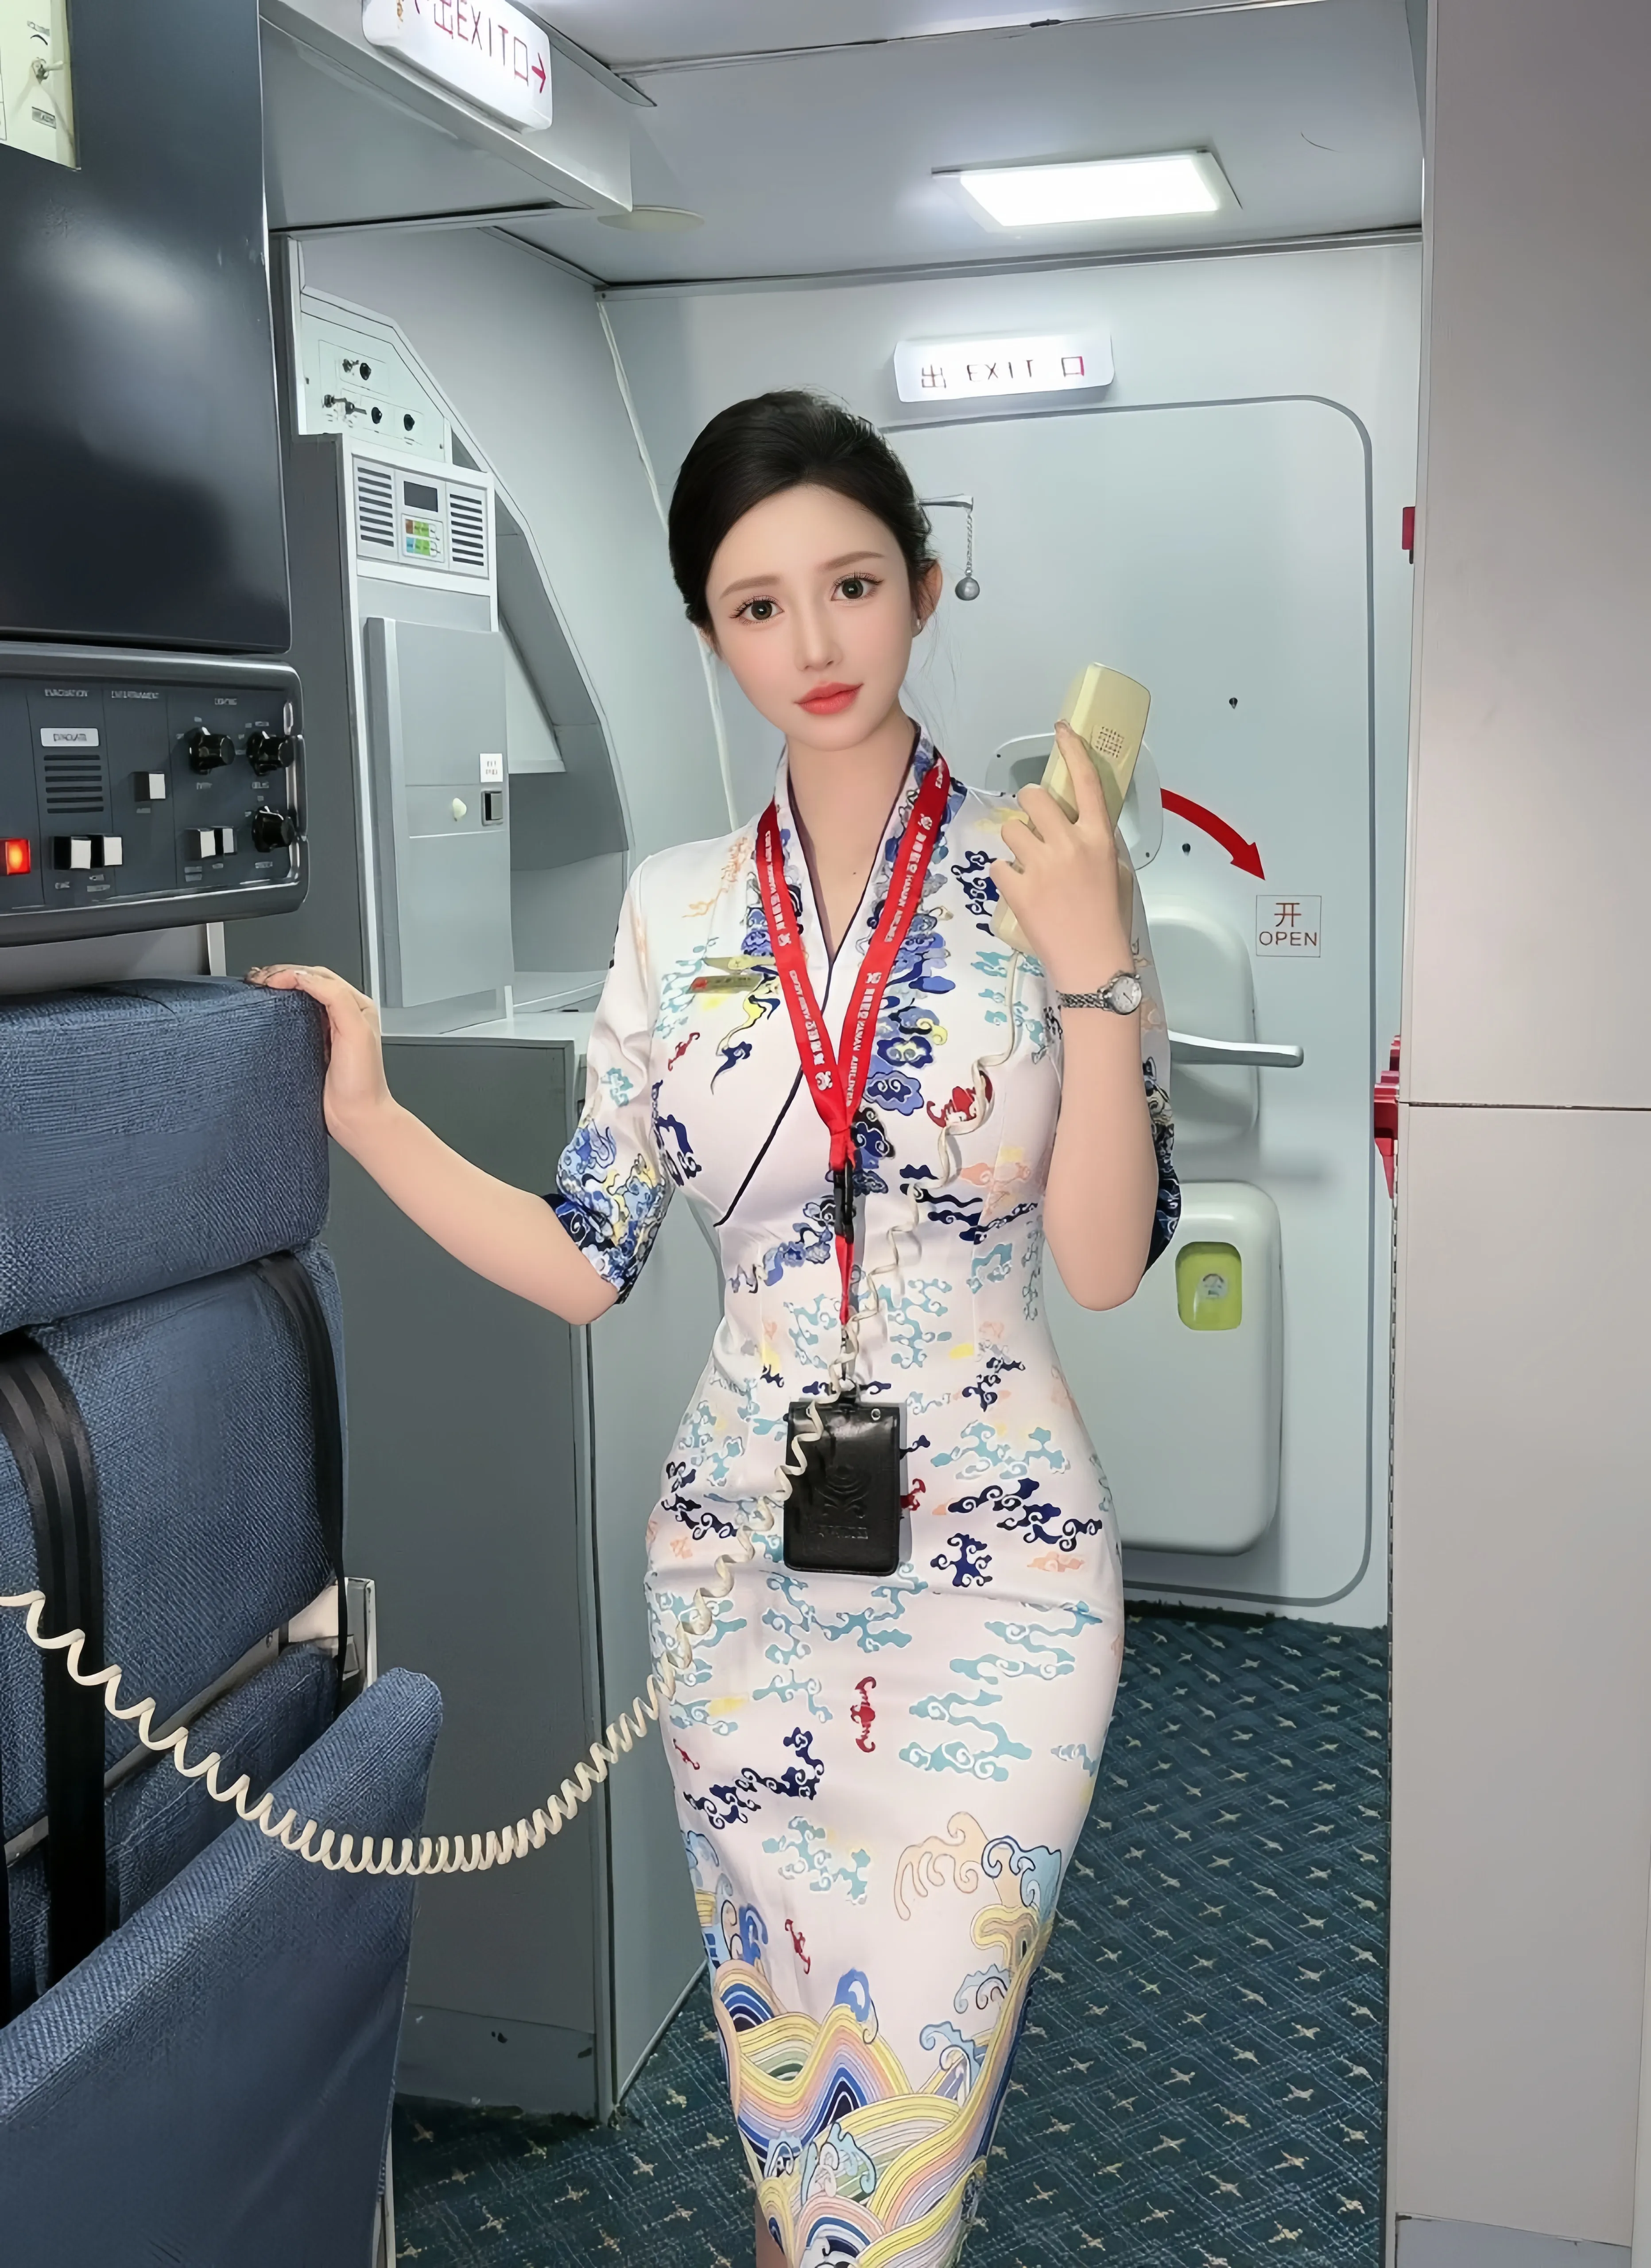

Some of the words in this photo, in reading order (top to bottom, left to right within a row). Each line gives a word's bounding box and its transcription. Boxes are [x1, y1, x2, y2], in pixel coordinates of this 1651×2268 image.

[457, 0, 509, 66] EXIT
[921, 364, 947, 388] 出
[967, 359, 1033, 381] EXIT
[1061, 356, 1085, 377] 口
[1274, 902, 1302, 928] 开
[1259, 931, 1317, 946] OPEN
